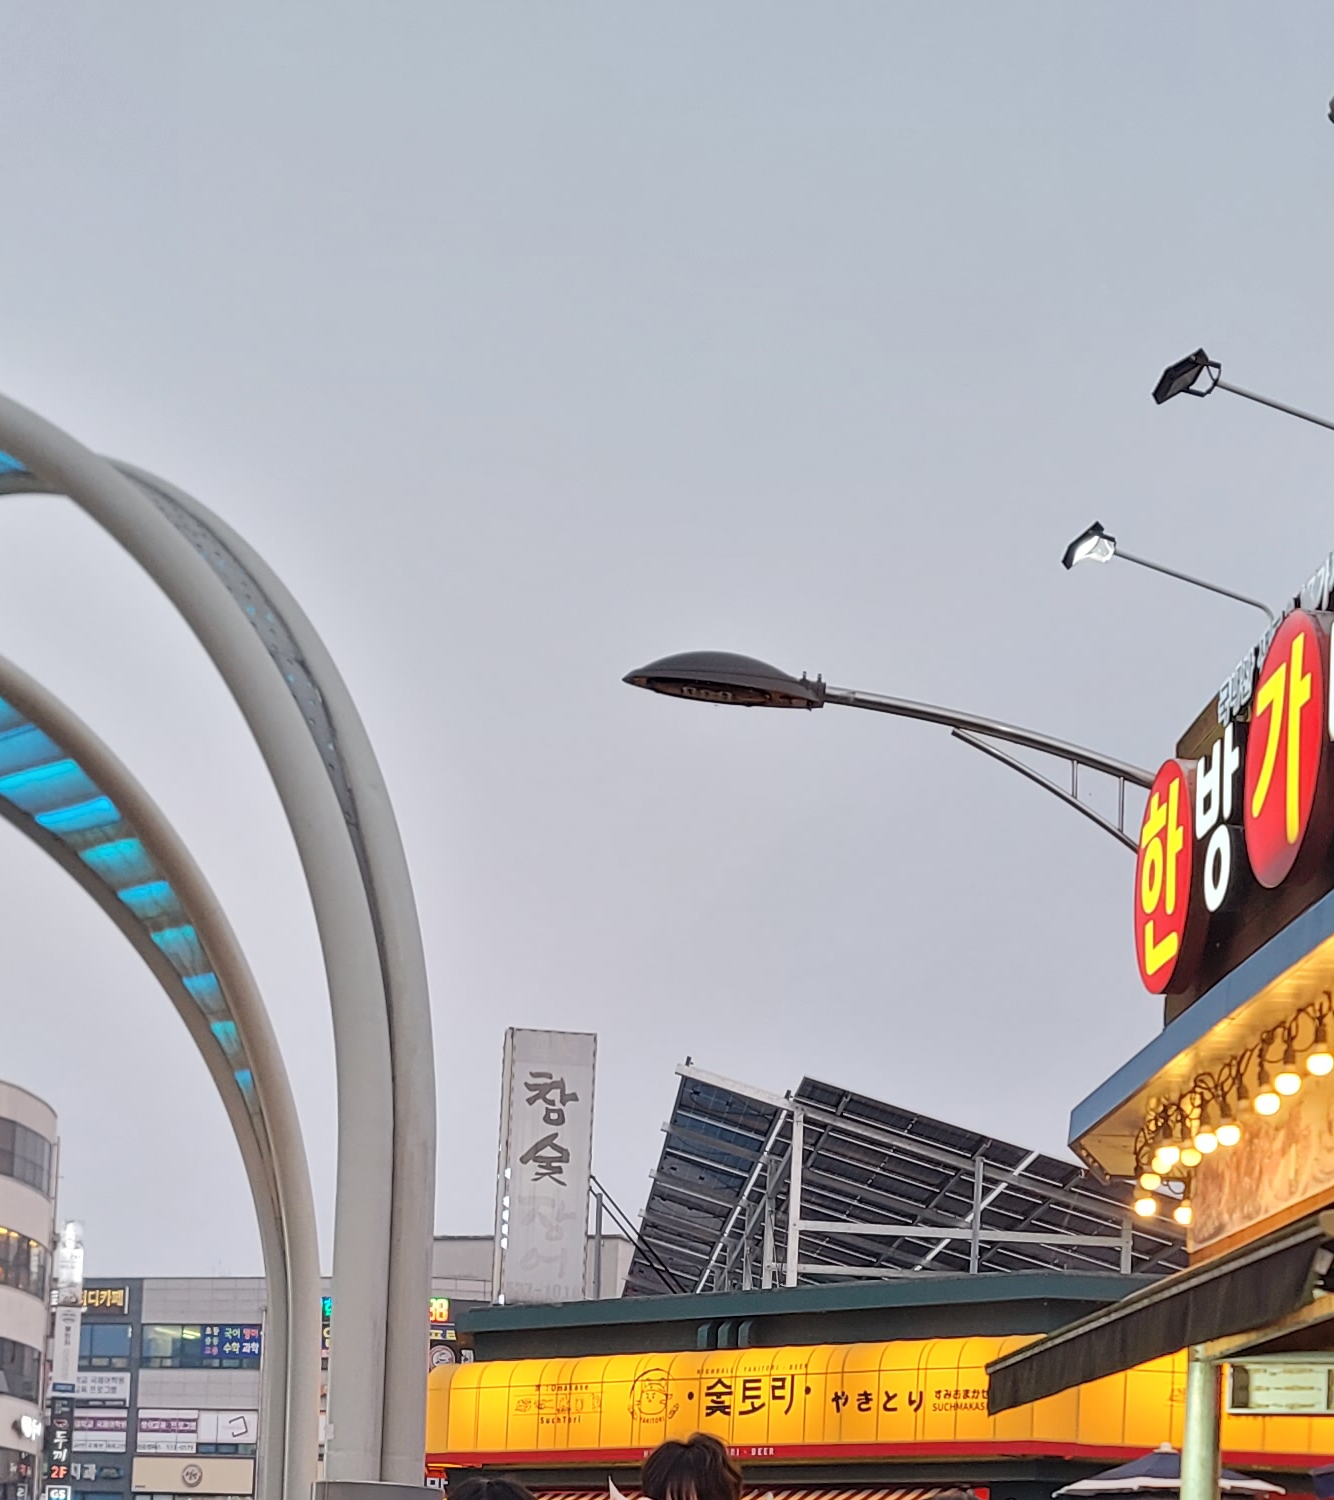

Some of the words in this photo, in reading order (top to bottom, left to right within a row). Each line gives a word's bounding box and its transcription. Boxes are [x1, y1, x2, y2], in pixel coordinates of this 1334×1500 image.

[704, 1374, 795, 1417] 숯토리
[831, 1389, 925, 1415] やきとり
[932, 1401, 989, 1412] SUCHMAKAS
[751, 1447, 775, 1457] BEER
[50, 1489, 66, 1499] GS
